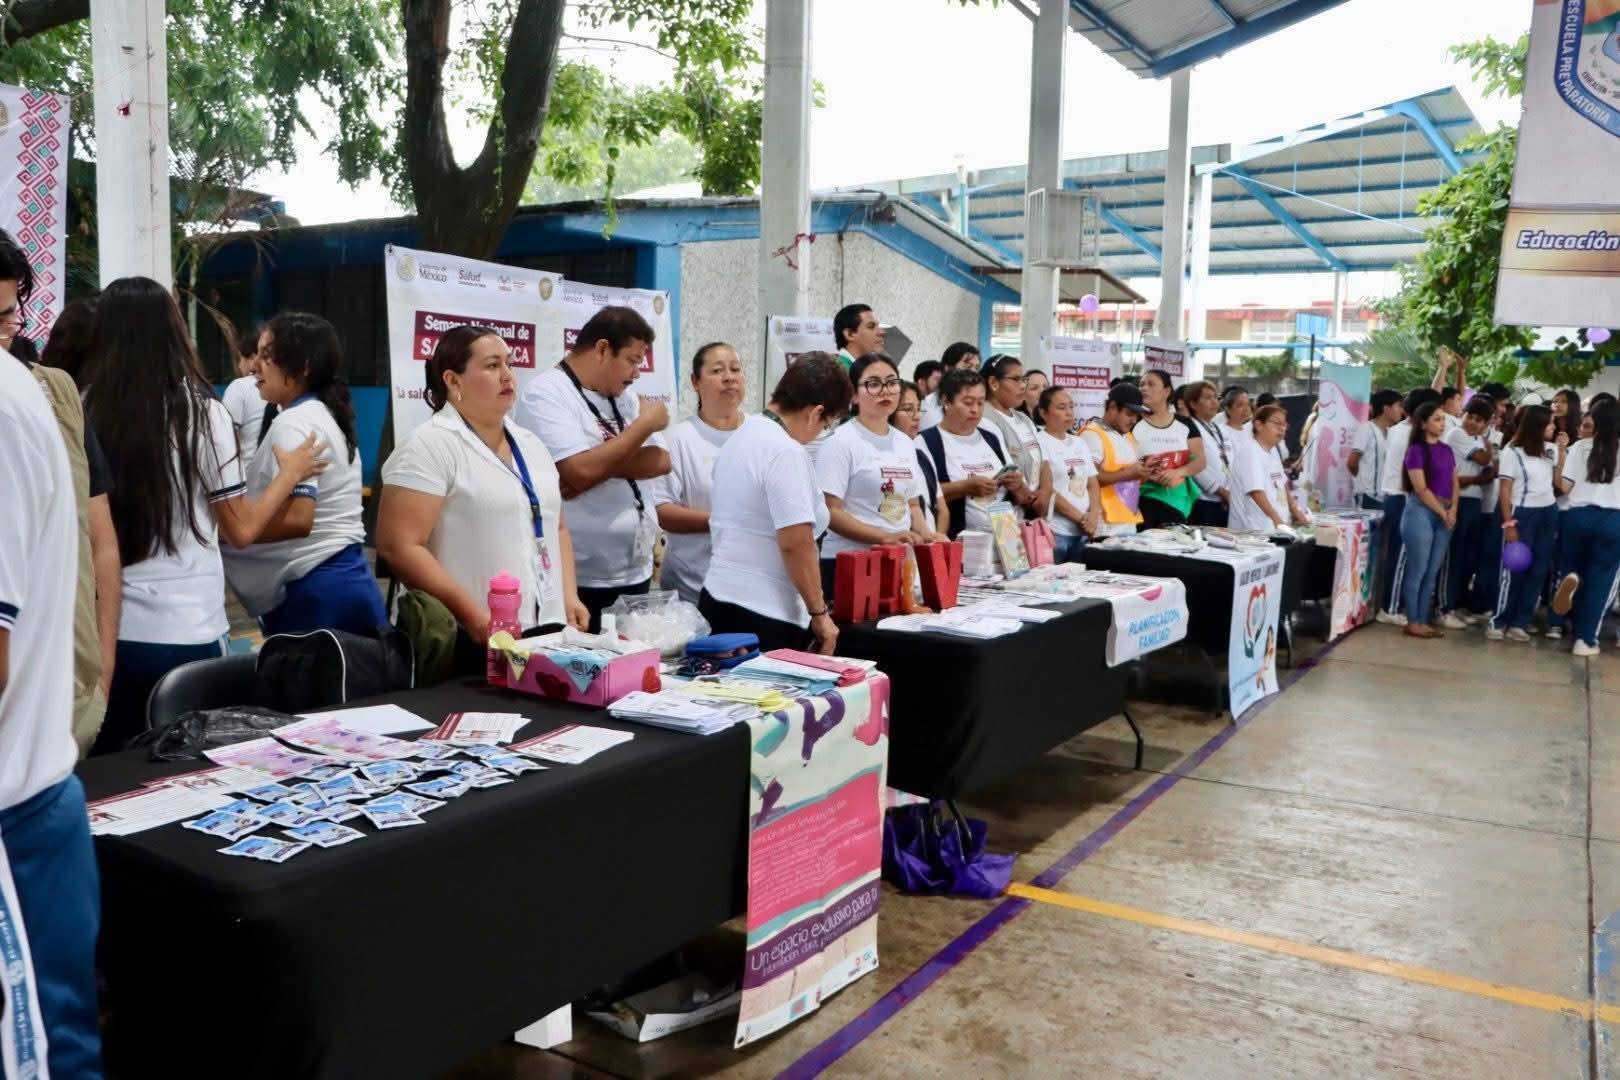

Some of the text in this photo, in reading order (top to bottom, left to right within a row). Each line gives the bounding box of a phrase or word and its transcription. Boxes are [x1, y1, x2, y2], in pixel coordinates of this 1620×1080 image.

[1559, 57, 1611, 124] PREPARATORIA
[1517, 230, 1620, 250] Educación
[458, 269, 482, 282] Salud
[518, 325, 529, 340] de
[1055, 376, 1078, 387] SALUD
[751, 950, 770, 971] Un
[771, 927, 809, 960] espacio
[810, 905, 852, 937] exclusivo
